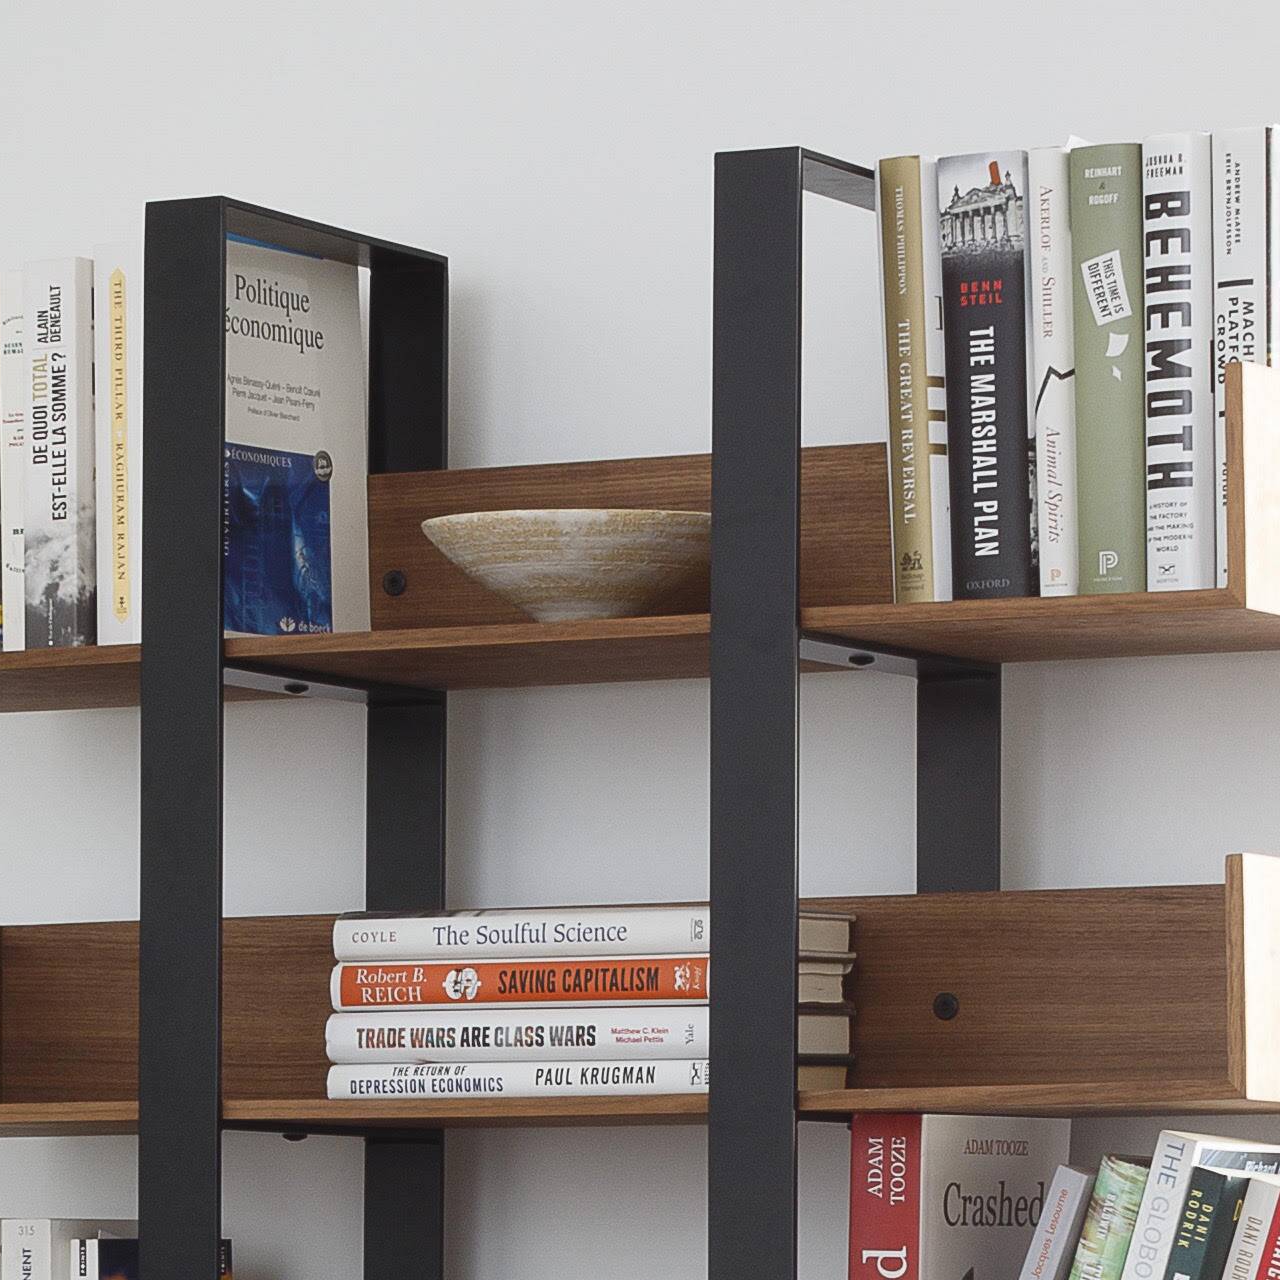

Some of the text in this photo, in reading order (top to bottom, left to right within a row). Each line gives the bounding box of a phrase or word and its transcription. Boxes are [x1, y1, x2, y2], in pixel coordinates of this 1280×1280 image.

[1084, 166, 1122, 178] REINHART
[1146, 167, 1184, 179] FREEMAN
[1040, 186, 1054, 251] AKERLOF
[1088, 193, 1119, 205] ROGOFF
[895, 186, 907, 295] THOMAS PHILIPPON
[235, 273, 310, 317] Politique
[960, 279, 1003, 307] BENN STEIL
[1042, 277, 1056, 338] SHILLER
[1087, 263, 1113, 318] DIFFERENT
[1102, 258, 1124, 314] THIS TIME IS
[37, 310, 49, 343] ALAIN
[50, 285, 61, 342] DENEAULT
[1145, 191, 1193, 490] BEHEMOTH
[32, 354, 48, 464] DE QUOI TOTAL
[114, 282, 125, 580] THE THIRD PILLAR RAGHURAM RAJAN
[897, 319, 917, 524] THE GREAT REVERSAL
[51, 364, 66, 520] EST-ELLE LA SOMME
[231, 451, 292, 468] ÉCONOMIQUES
[970, 326, 1000, 556] THE MARSHALL PLAN
[1044, 427, 1063, 543] Animal Spirits
[966, 578, 1010, 590] OXFORD
[352, 922, 628, 946] COYLE The Soulful Science
[356, 968, 427, 984] Robert B.
[361, 986, 422, 1003] REICH
[498, 967, 659, 994] SAVING CAPITALISM
[357, 1025, 596, 1048] TRADE WARS ARE CLASS WARS
[611, 1027, 641, 1035] Matthew
[350, 1077, 503, 1095] DEPRESSION ECONOMICS
[392, 1065, 468, 1077] THE RETURN OF
[535, 1066, 656, 1086] PAUL KRUGMAN
[867, 1137, 884, 1198] ADAM
[890, 1136, 906, 1206] TOOZE
[1156, 1142, 1186, 1189] THE
[943, 1181, 1045, 1228] Crashed
[1177, 1189, 1203, 1249] RODRIK
[1194, 1203, 1214, 1242] DANI
[1242, 1216, 1263, 1248] DANI
